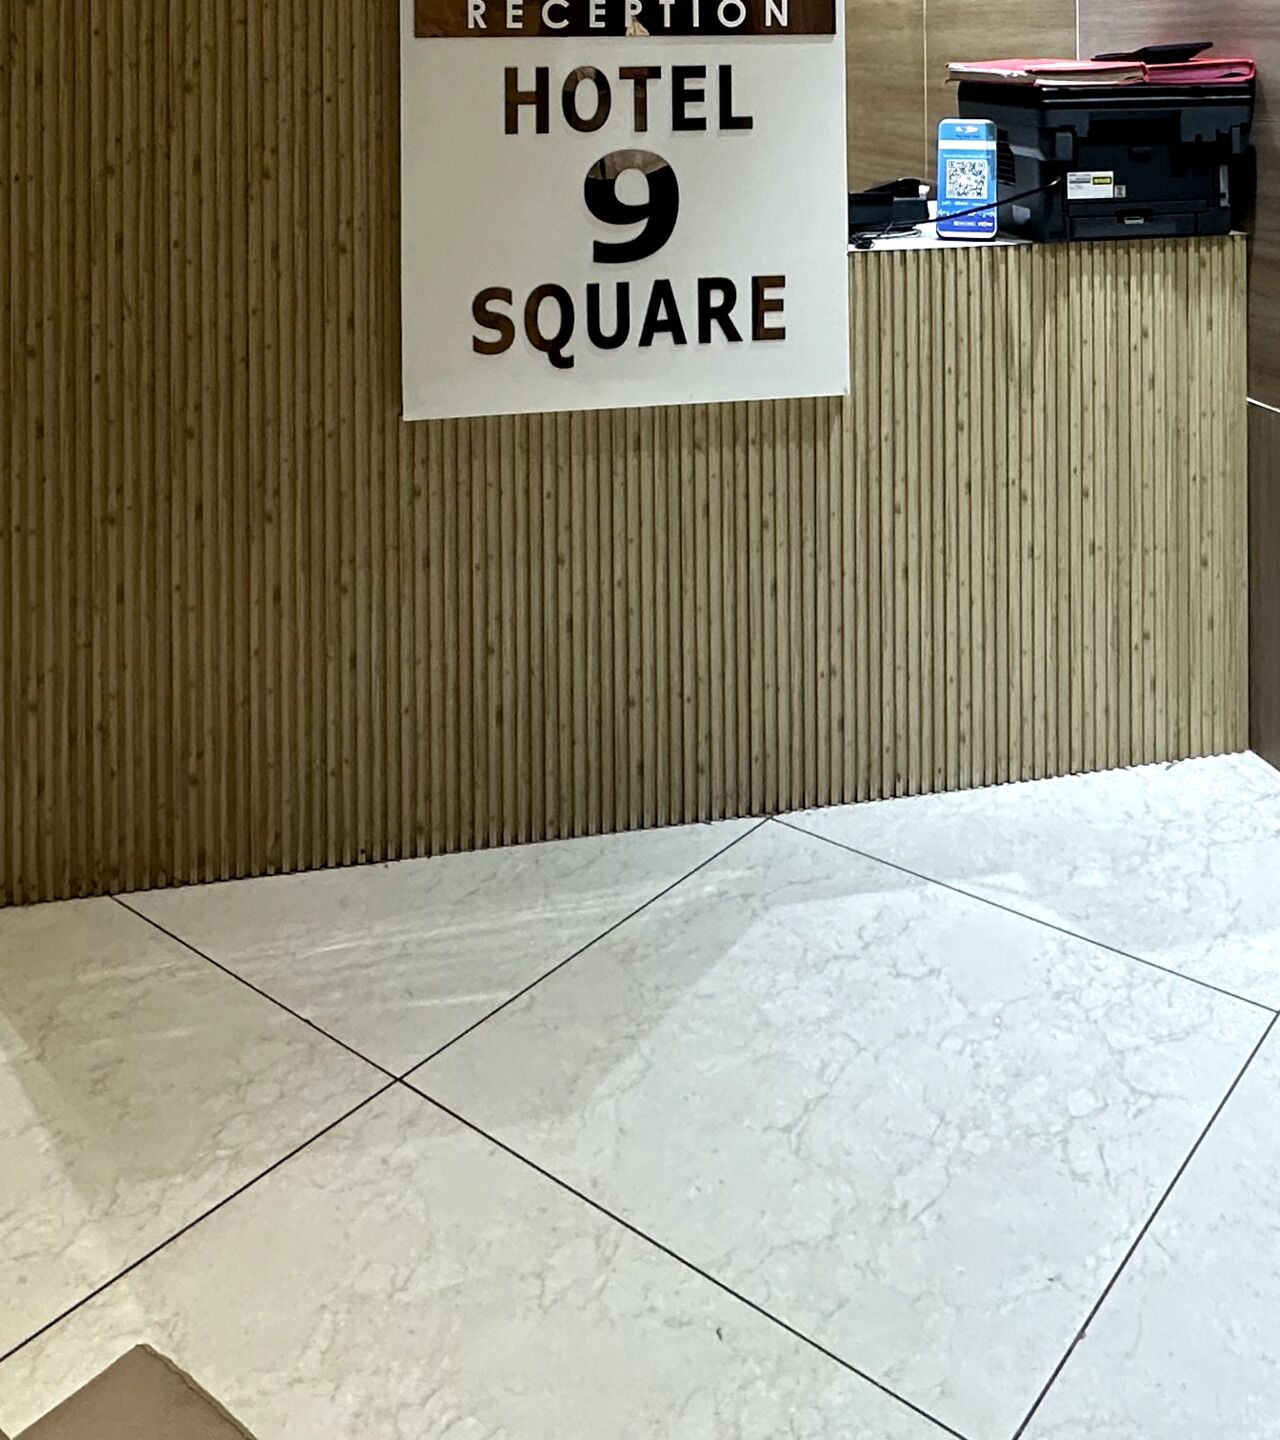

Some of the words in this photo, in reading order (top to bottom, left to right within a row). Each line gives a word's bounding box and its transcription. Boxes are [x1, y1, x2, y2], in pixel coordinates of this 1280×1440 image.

[504, 65, 753, 135] HOTEL
[584, 149, 680, 264] 9
[472, 275, 787, 369] SQUARE
